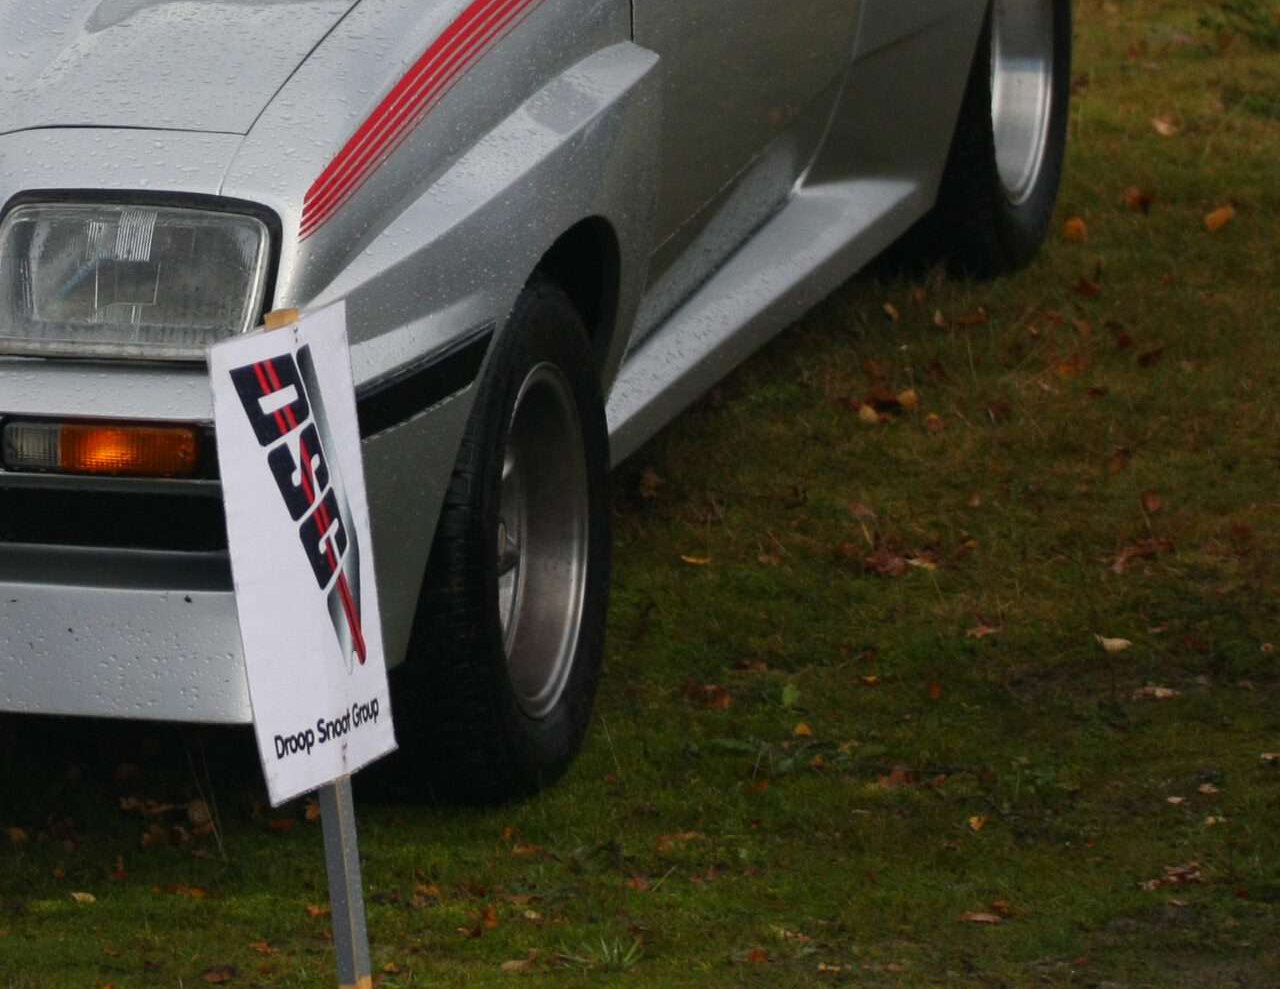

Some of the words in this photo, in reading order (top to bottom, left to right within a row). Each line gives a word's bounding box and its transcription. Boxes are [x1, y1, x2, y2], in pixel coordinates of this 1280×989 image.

[274, 728, 315, 760] Droop
[317, 708, 351, 744] Snoot
[352, 697, 380, 728] Group
